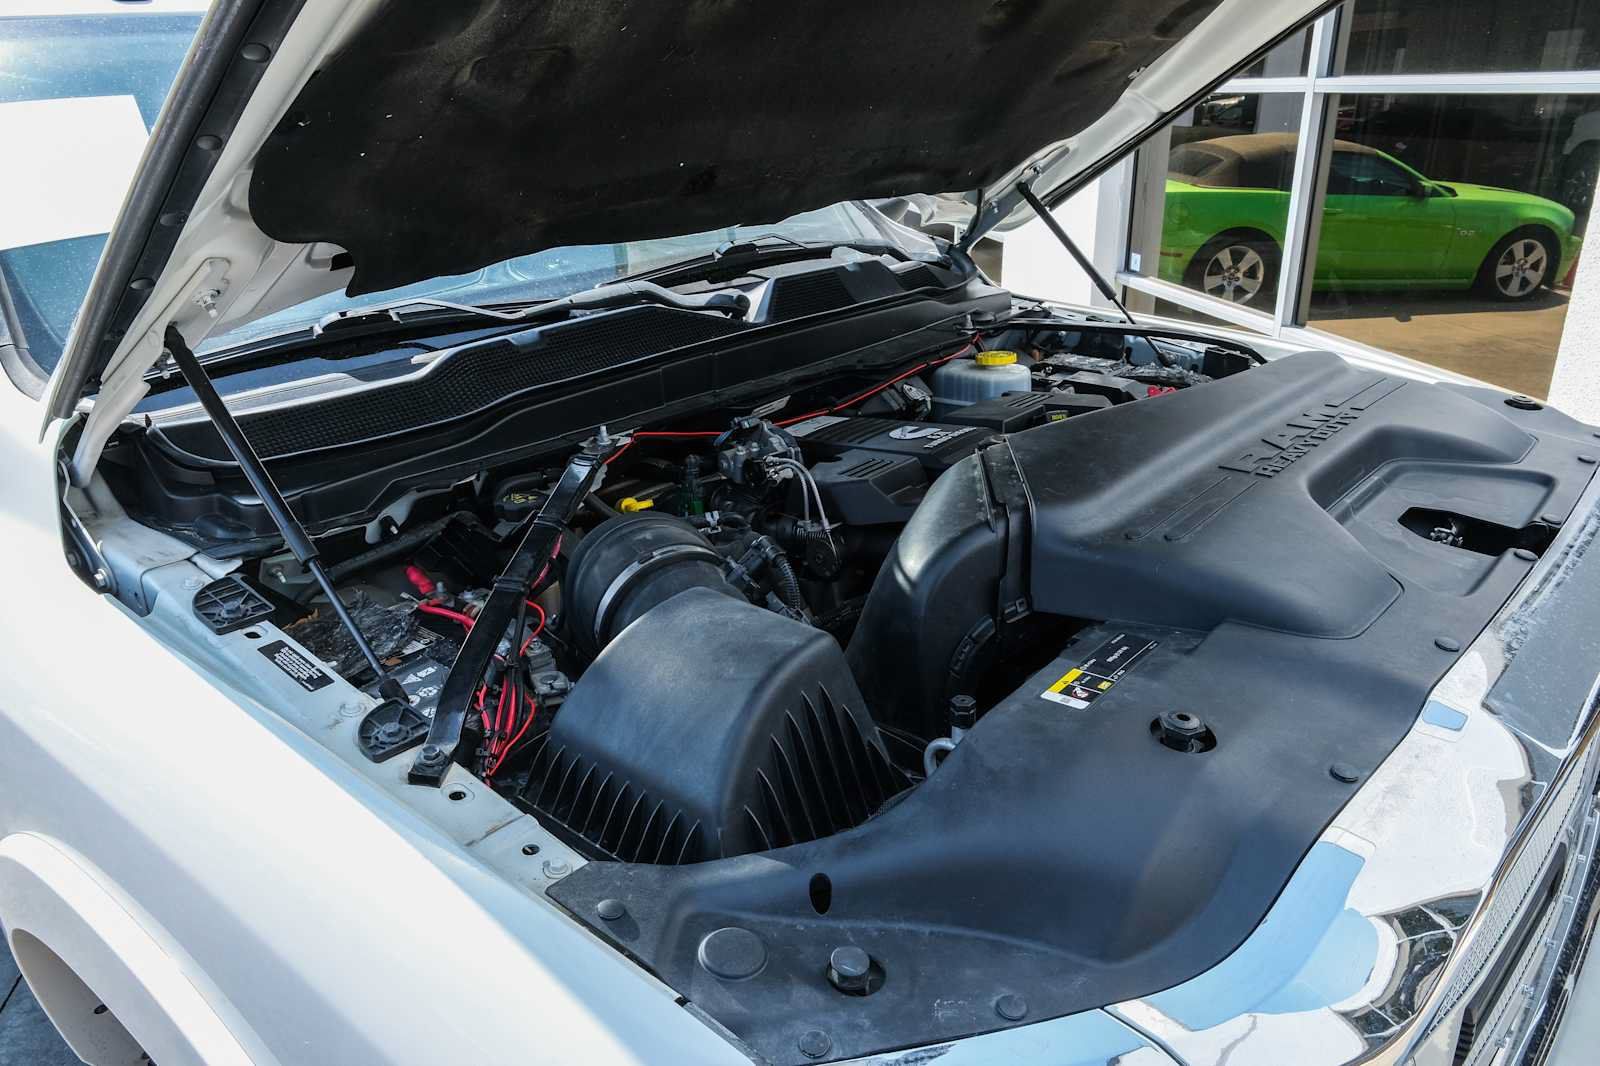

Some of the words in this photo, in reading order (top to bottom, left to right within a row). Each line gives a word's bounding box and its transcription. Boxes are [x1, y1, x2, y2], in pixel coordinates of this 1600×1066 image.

[1217, 403, 1343, 474] RAM
[1255, 440, 1320, 478] HEAVY
[1310, 413, 1358, 440] DUTY
